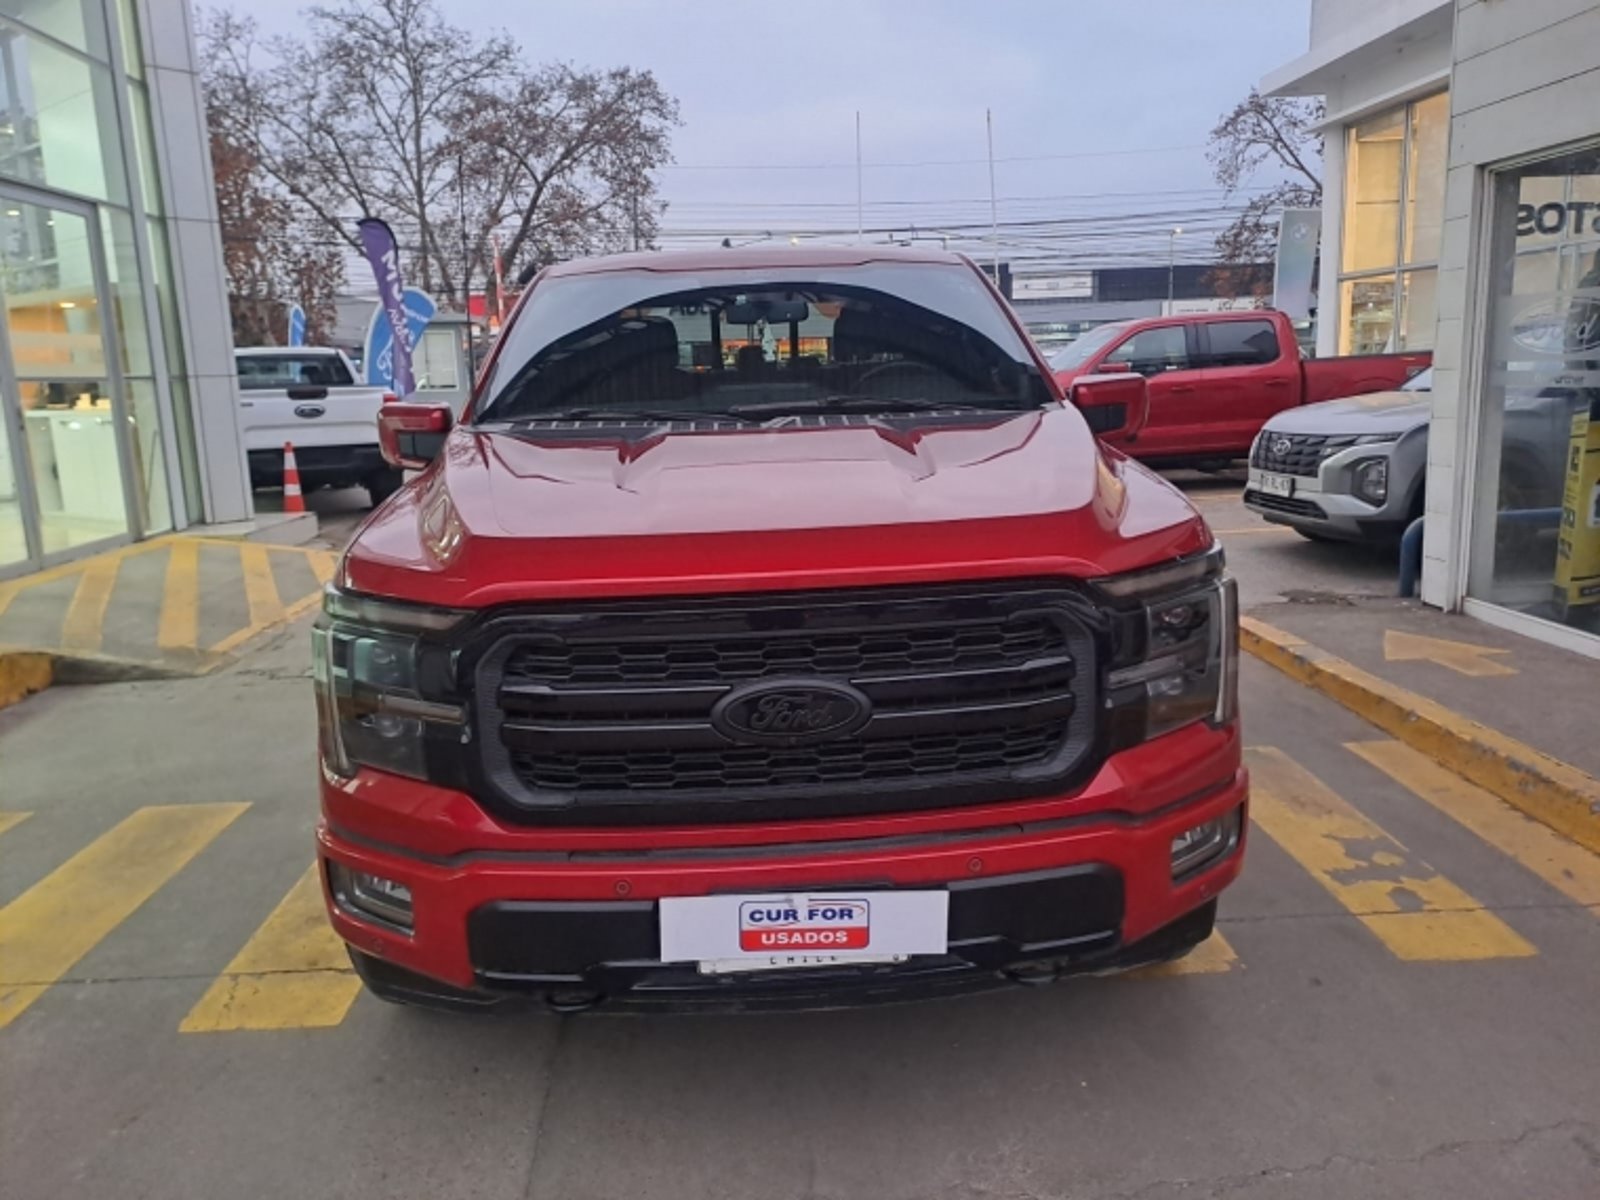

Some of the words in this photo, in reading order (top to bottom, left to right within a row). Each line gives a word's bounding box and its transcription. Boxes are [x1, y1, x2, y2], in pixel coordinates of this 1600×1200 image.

[751, 694, 833, 729] Ford
[749, 908, 799, 922] CUR
[808, 907, 854, 921] FOR
[761, 930, 848, 945] USADOS
